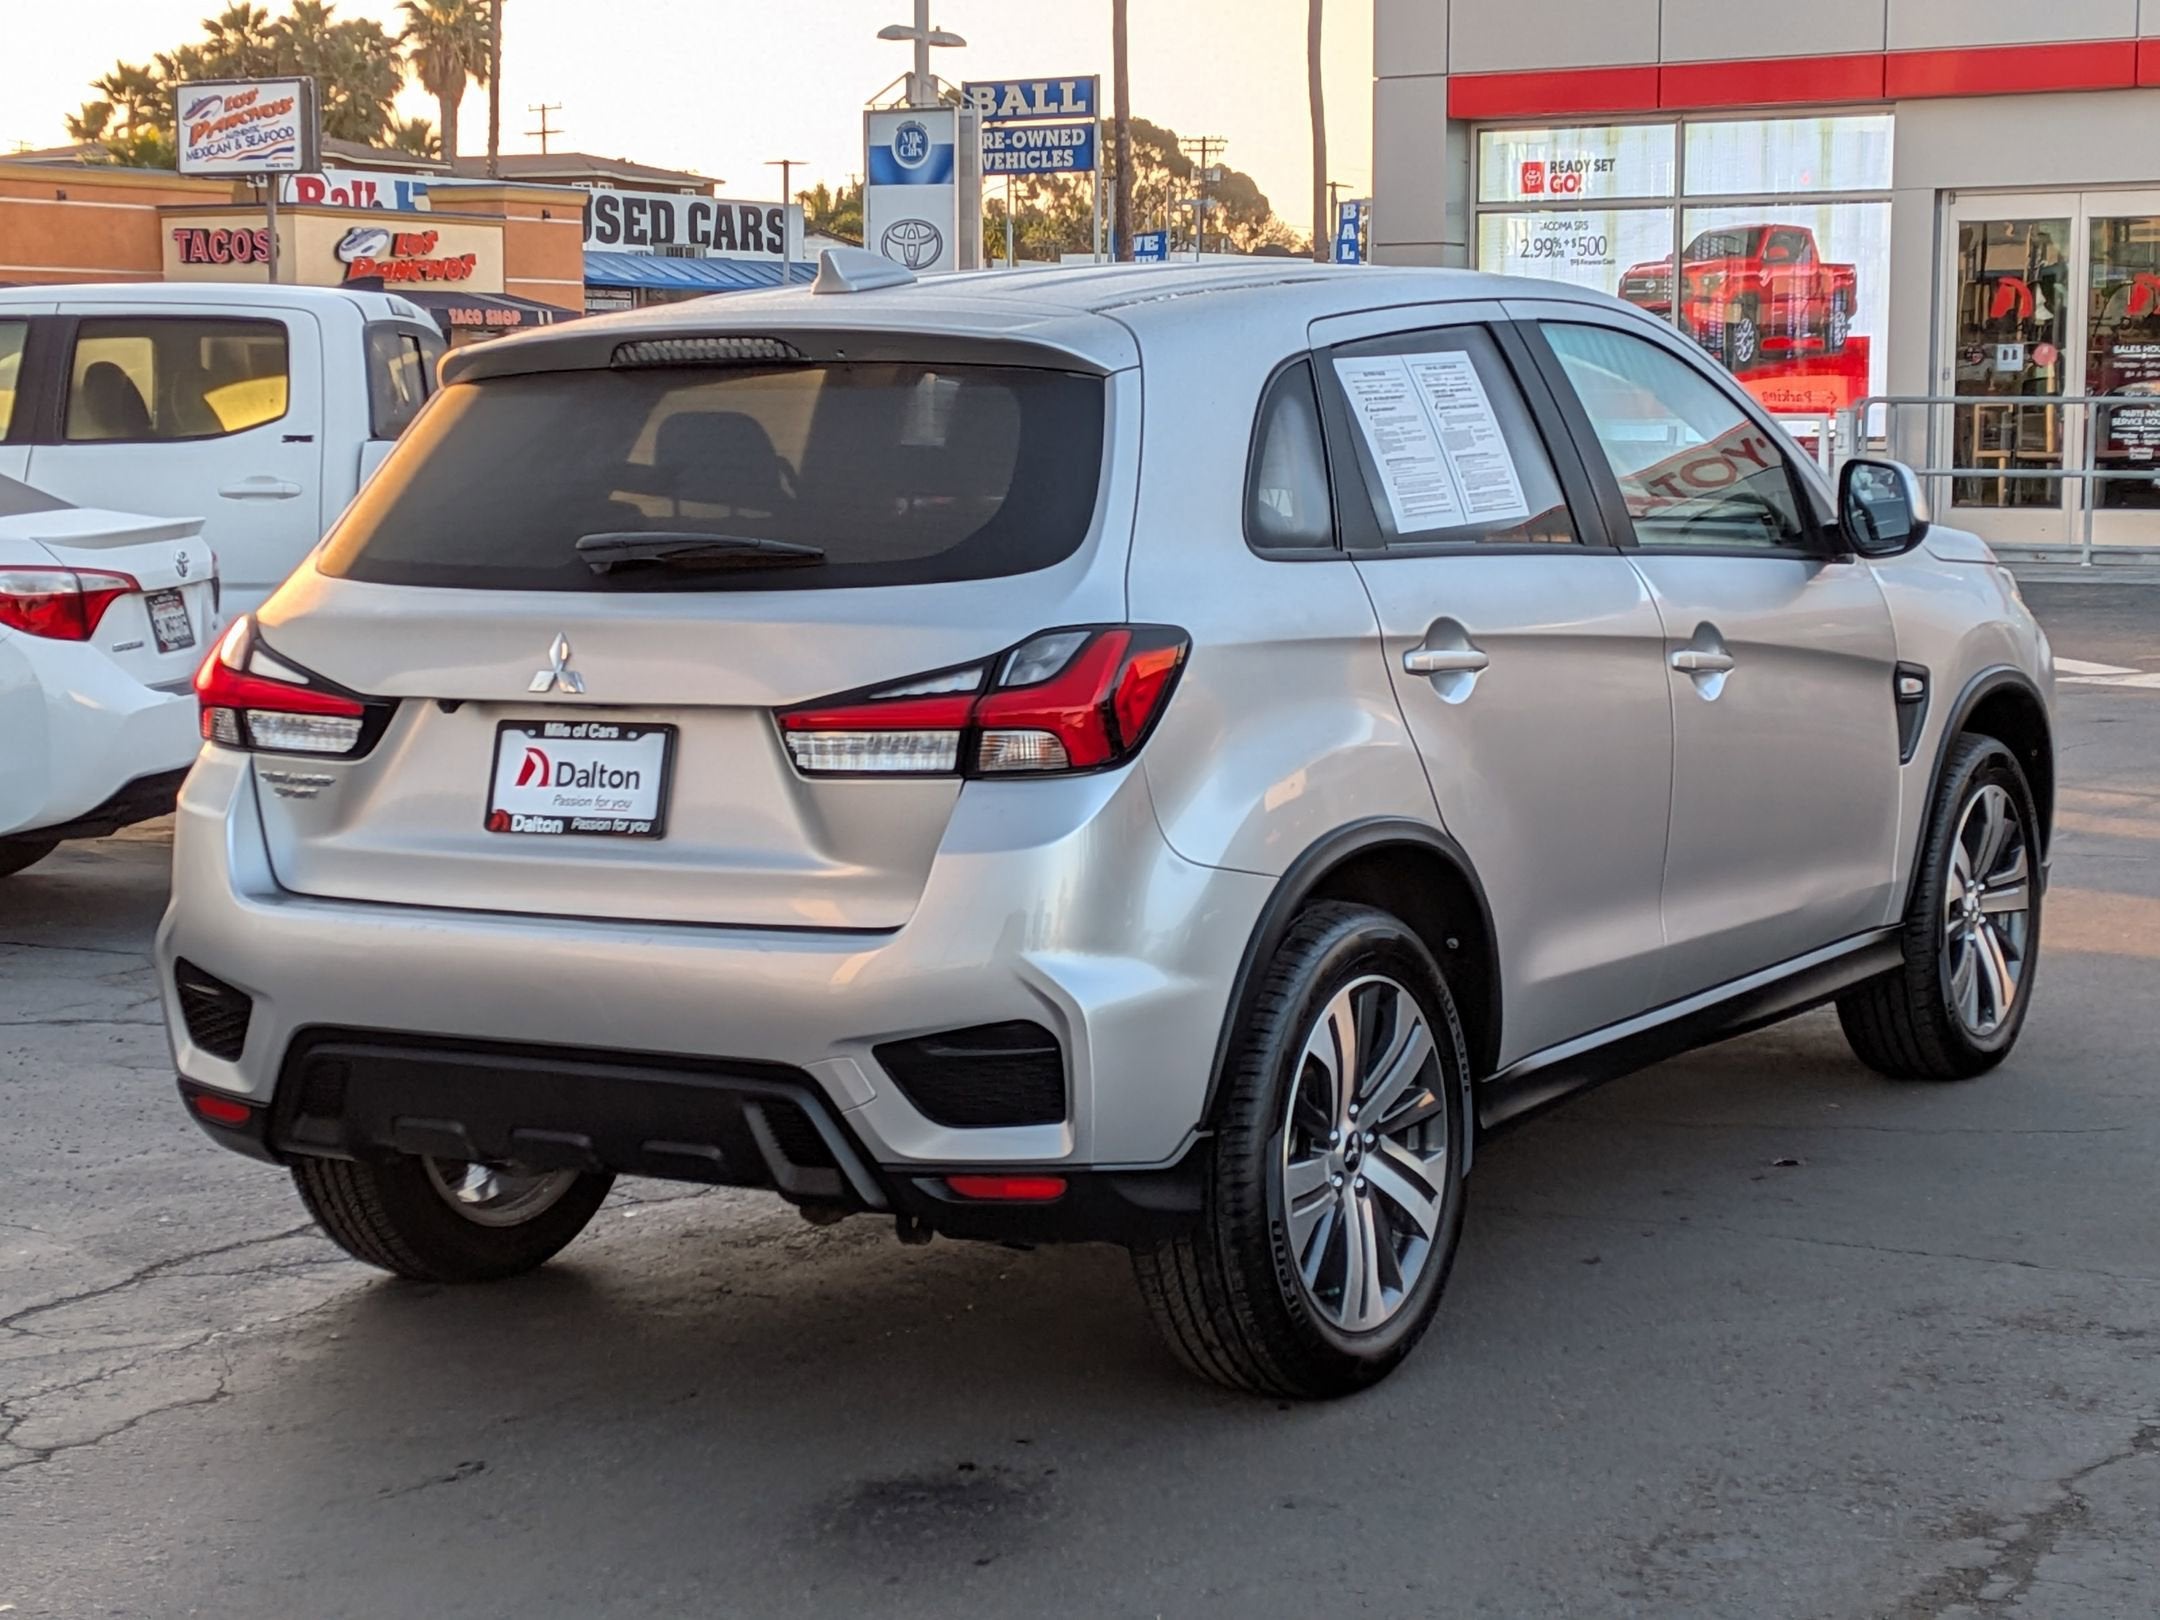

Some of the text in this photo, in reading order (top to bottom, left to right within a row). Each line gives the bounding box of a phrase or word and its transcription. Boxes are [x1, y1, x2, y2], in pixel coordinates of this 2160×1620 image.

[970, 82, 1086, 117] BALL
[186, 126, 294, 161] MEXICAN & SEAFOOD
[983, 149, 1074, 170] VEHICLES
[1550, 158, 1615, 173] READY SET
[1550, 174, 1582, 193] GO!
[688, 202, 784, 254] CARS
[173, 228, 272, 263] TACOS
[448, 308, 522, 325] TACO SHOP
[2113, 345, 2141, 353] SALES
[544, 723, 619, 738] Mile of Cars
[555, 761, 640, 790] Dalton
[552, 794, 633, 810] Passion for you
[511, 814, 652, 834] Dalton Passion for you
